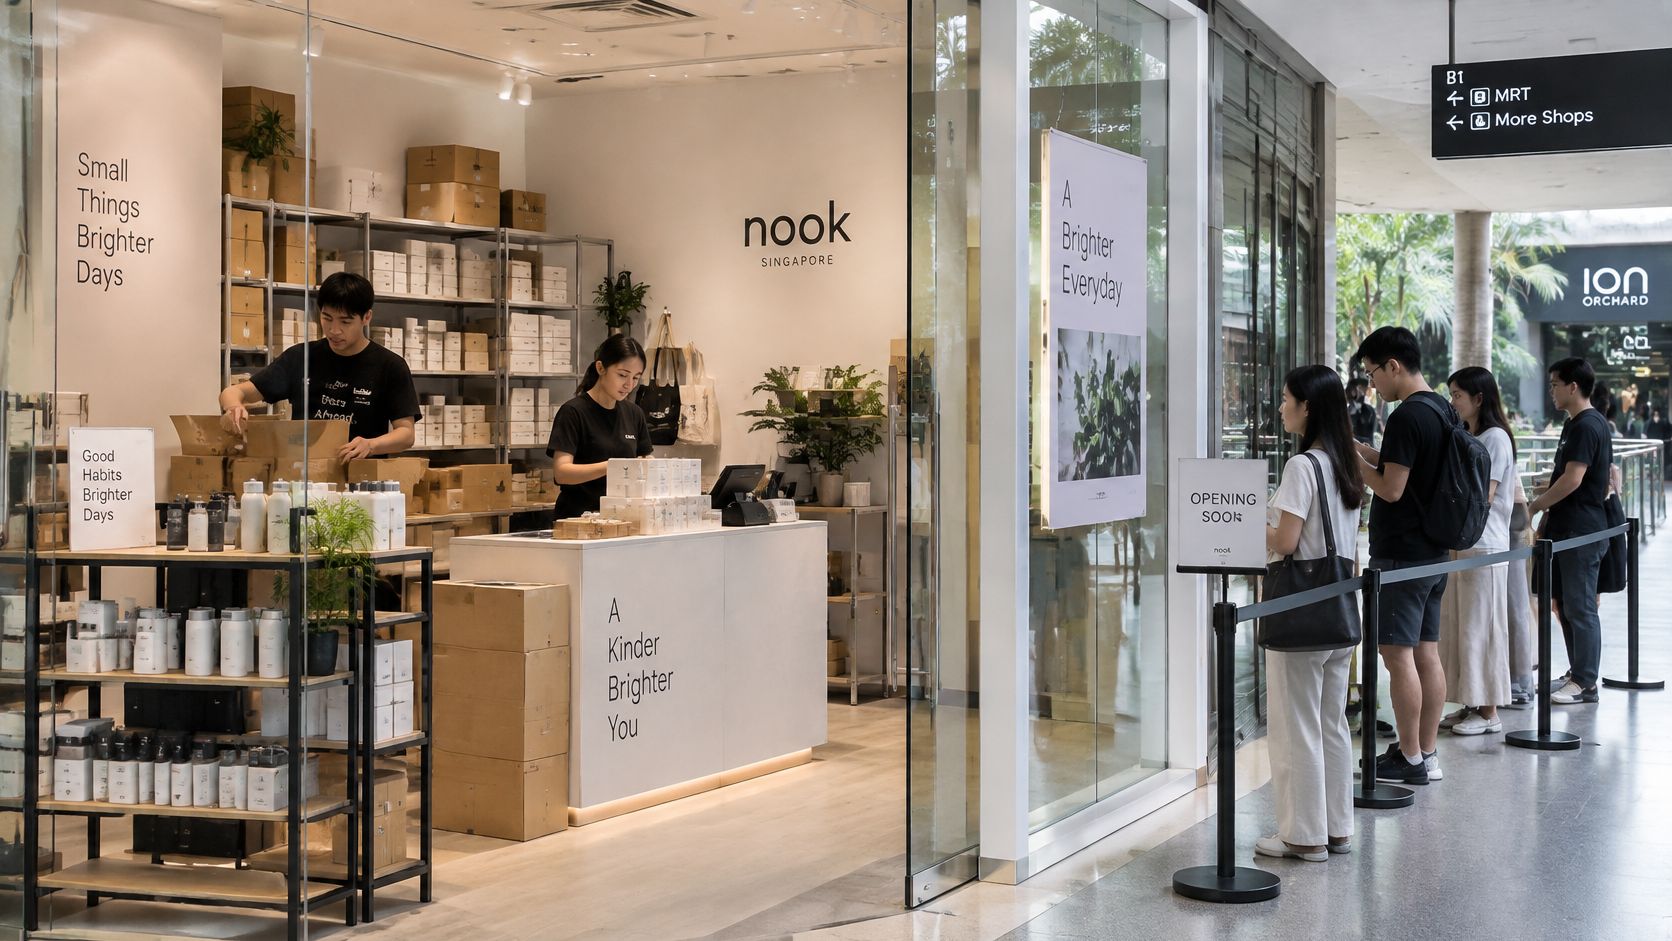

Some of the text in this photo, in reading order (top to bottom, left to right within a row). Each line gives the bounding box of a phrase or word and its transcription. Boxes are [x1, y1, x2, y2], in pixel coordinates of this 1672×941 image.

[1446, 70, 1464, 85] B1
[1494, 87, 1532, 102] MRT
[1495, 109, 1594, 127] More Shops
[78, 152, 128, 182] Small
[77, 187, 141, 223] Things
[1062, 179, 1072, 209] A
[744, 200, 852, 248] nook
[77, 222, 155, 257] Brighter
[1062, 221, 1114, 262] Brighter
[761, 254, 834, 267] SINGAPORE
[77, 259, 123, 292] Days
[1062, 264, 1123, 307] Everyday
[1582, 295, 1649, 307] ORCHARD
[82, 449, 115, 462] Good
[83, 468, 122, 481] Habits
[83, 488, 133, 504] Brighter
[1190, 492, 1257, 506] OPENING
[83, 508, 114, 523] Days
[608, 597, 621, 624] A
[608, 631, 660, 663] Kinder
[608, 669, 674, 705] Brighter
[607, 713, 638, 742] You
